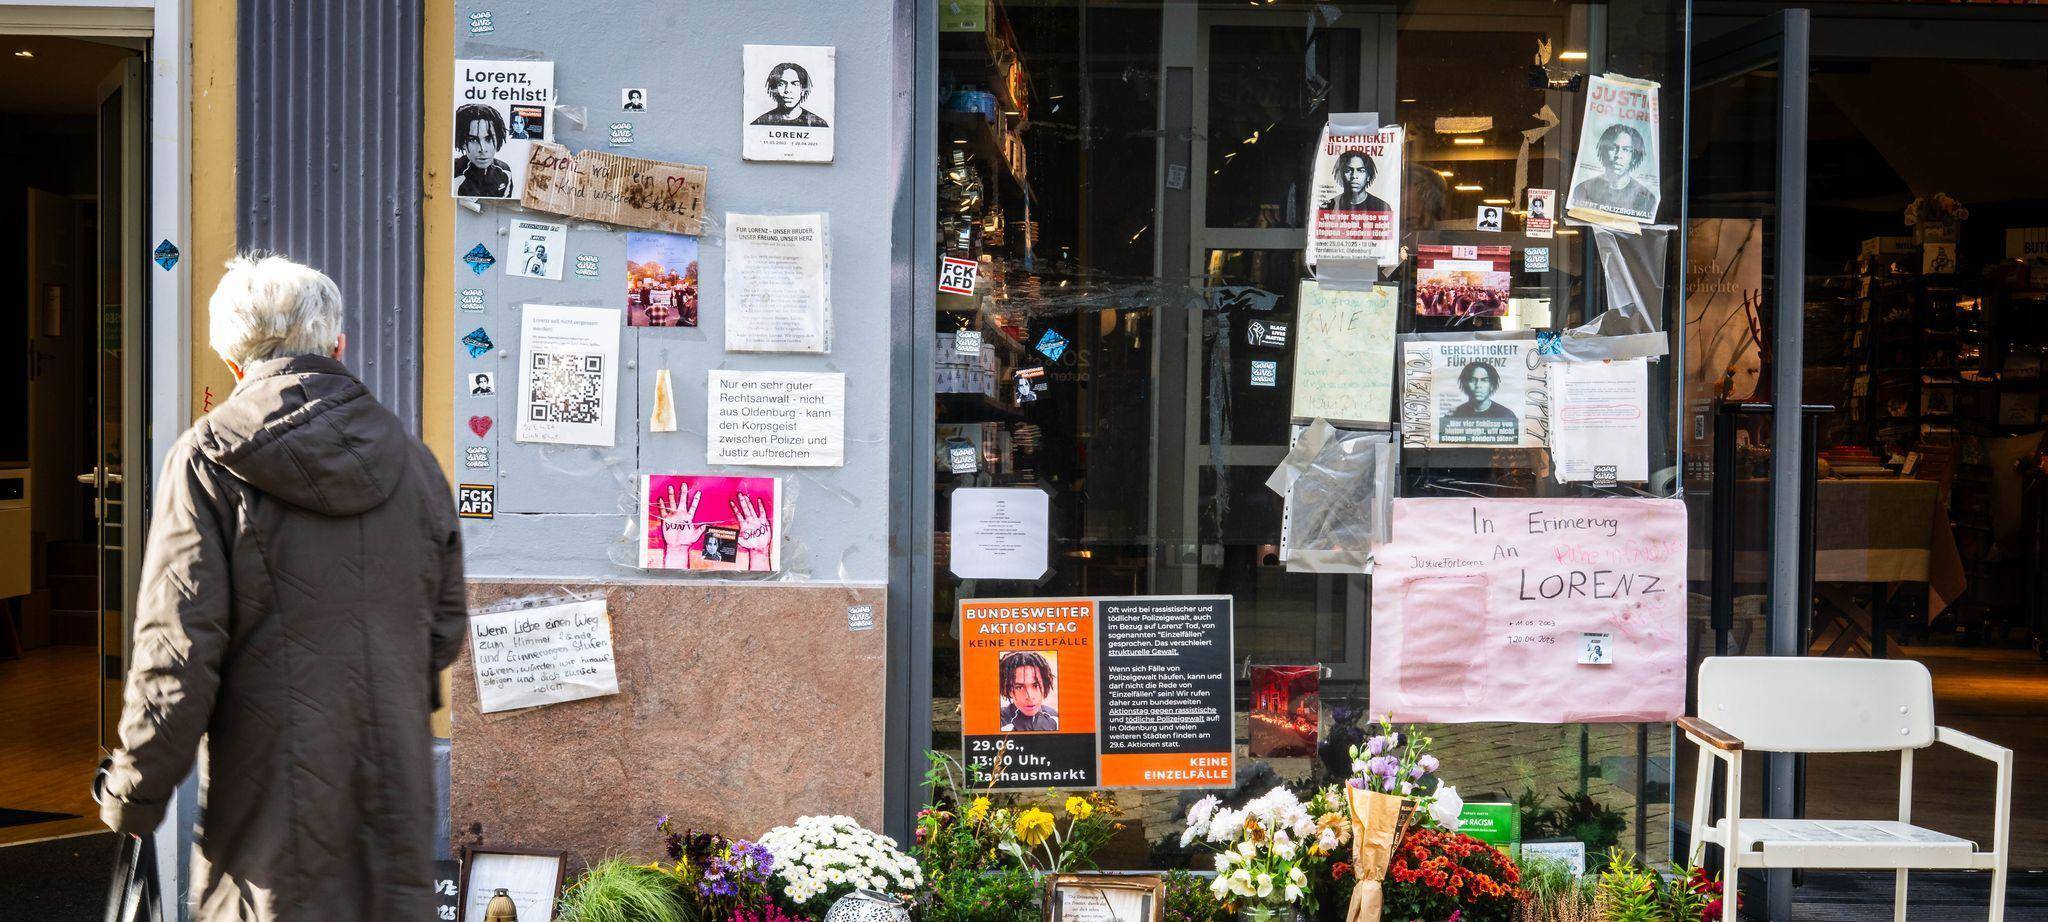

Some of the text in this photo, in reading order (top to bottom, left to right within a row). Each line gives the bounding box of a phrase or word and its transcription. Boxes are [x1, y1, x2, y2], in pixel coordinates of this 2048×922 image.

[466, 68, 531, 86] Lorenz,
[465, 86, 547, 102] du fehlst!
[769, 131, 810, 140] LORENZ
[944, 263, 975, 278] FCK
[942, 275, 972, 289] AFD
[1319, 310, 1363, 335] WIE
[1440, 344, 1520, 356] GERECHTIGKEIT
[1447, 355, 1465, 368] FÜR
[720, 380, 813, 392] Nur ein sehr guter
[720, 393, 824, 404] Rechtsanwalt nicht
[719, 406, 831, 419] aus Oldenburg kann
[719, 421, 797, 432] den Korpsgeist
[719, 434, 827, 445] zwischen Polizei und
[719, 448, 810, 458] Justiz aufbrechen
[460, 490, 492, 502] FCK
[460, 502, 492, 514] AFD
[1473, 507, 1618, 538] In Erinnerung
[1493, 544, 1518, 561] An
[1519, 569, 1666, 601] LORENZ
[966, 606, 1090, 620] BUNDESWEITER
[1108, 606, 1120, 614] Oft
[1152, 605, 1196, 613] rassistischer
[1108, 614, 1141, 622] tödlicher
[1142, 614, 1192, 622] Polizeigewalt,
[476, 612, 599, 638] Wenn Liebe einen Weg
[978, 621, 1078, 634] AKTIONSTAG
[1119, 623, 1143, 632] Bezug
[1144, 622, 1156, 630] auf
[1185, 622, 1200, 631] Tod,
[1108, 632, 1156, 640] sogenannten
[479, 640, 504, 650] zum
[969, 636, 1088, 648] KEINE EINZELFÄLLE
[1108, 640, 1153, 649] gesprochen.
[506, 646, 568, 664] Erinnerungen
[1108, 648, 1180, 656] strukturelle Gewalt.
[1109, 673, 1157, 682] Polizeigewalt
[1158, 674, 1186, 682] häufen,
[1109, 682, 1124, 690] darf
[1190, 689, 1210, 697] rufen
[1149, 698, 1202, 706] bundesweiten
[1109, 706, 1217, 716] Aktionstag gegen rassistische
[1125, 715, 1155, 724] tödliche
[1156, 714, 1205, 724] Polizeigewalt
[1118, 724, 1158, 732] Oldenburg
[1143, 732, 1172, 740] Städten
[1173, 731, 1197, 739] finden
[972, 740, 1024, 752] 29.06.,
[1127, 740, 1160, 748] Aktionen
[1161, 740, 1181, 748] statt.
[1018, 754, 1051, 766] Uhr,
[1190, 757, 1228, 766] KEINE
[1144, 768, 1229, 780] EINZELFÄLLE
[1469, 818, 1494, 826] RACISM
